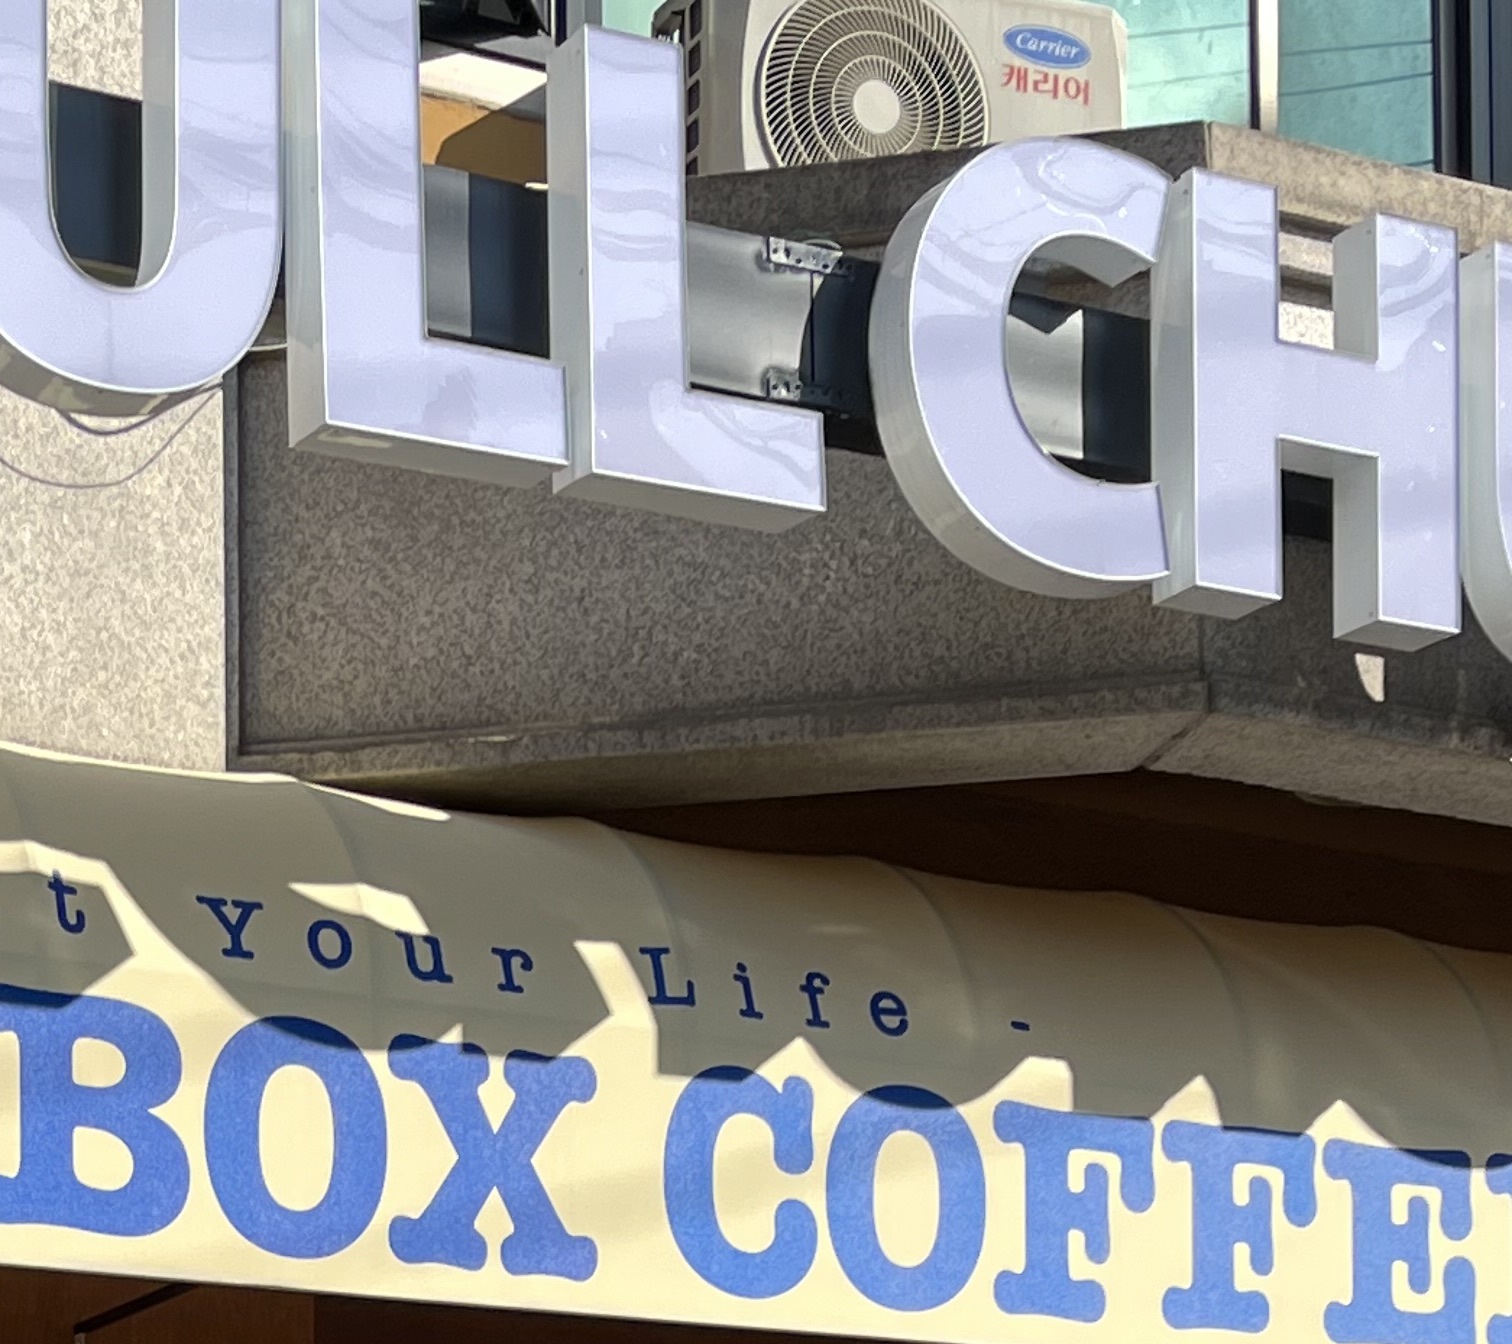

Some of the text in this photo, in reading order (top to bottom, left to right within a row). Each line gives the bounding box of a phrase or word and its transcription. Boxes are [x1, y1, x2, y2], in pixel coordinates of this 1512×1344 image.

[1000, 63, 1091, 107] 캐리어
[1015, 31, 1081, 60] Carrier
[870, 135, 1512, 667] CH
[196, 893, 535, 993] Your
[639, 946, 910, 1037] Life
